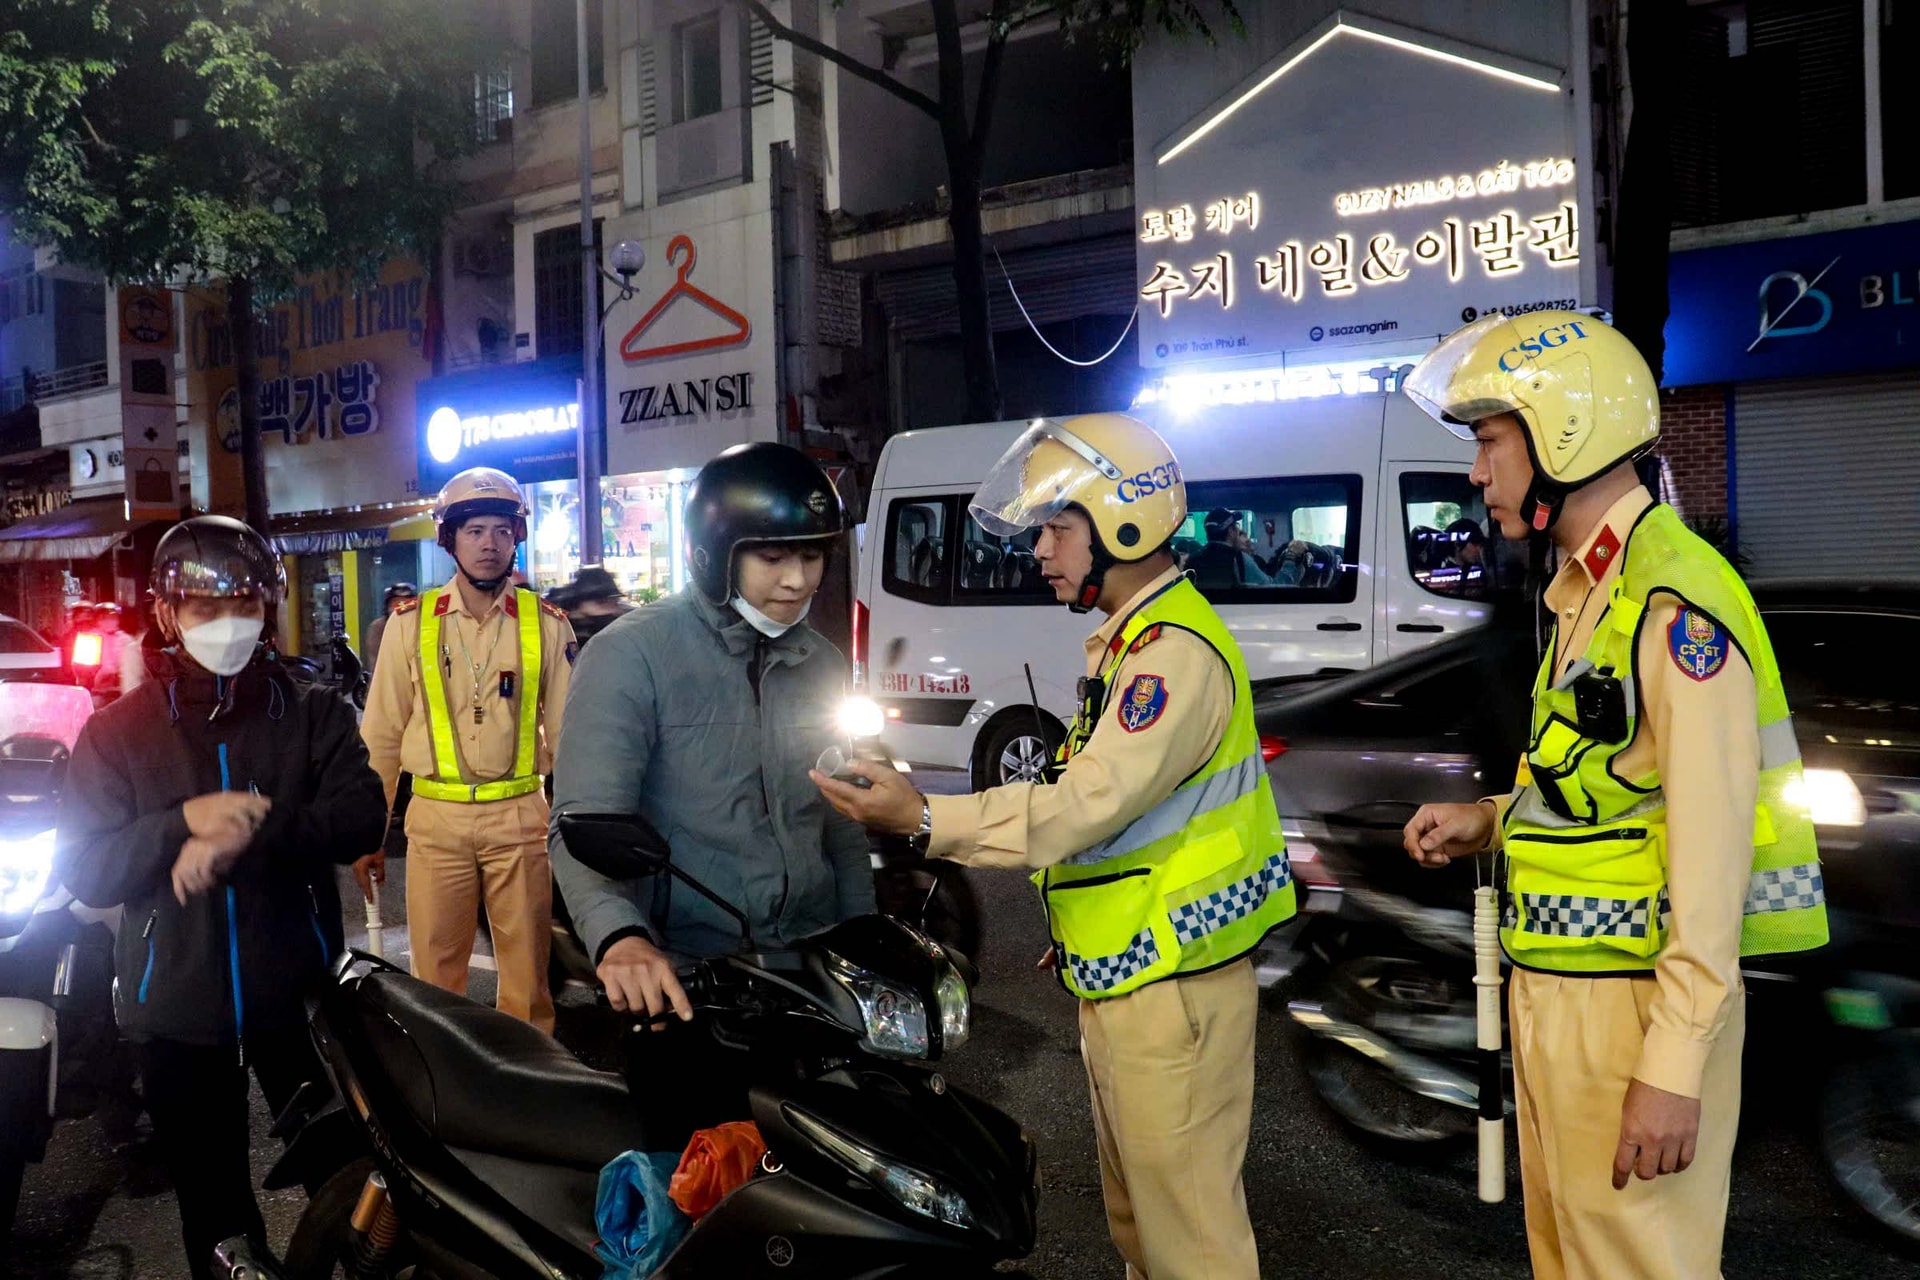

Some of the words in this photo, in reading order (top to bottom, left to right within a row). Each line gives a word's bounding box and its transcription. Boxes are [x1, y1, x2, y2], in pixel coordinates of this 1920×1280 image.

[1205, 192, 1258, 234] 케어
[1337, 188, 1391, 215] SUZY
[1393, 178, 1454, 208] NAILS
[1140, 251, 1233, 317] 수지
[1860, 269, 1920, 309] BL
[1329, 320, 1398, 337] ssazangnim
[1499, 321, 1588, 373] CSGT
[619, 372, 751, 424] ZZANSI
[1117, 461, 1180, 503] CSGT
